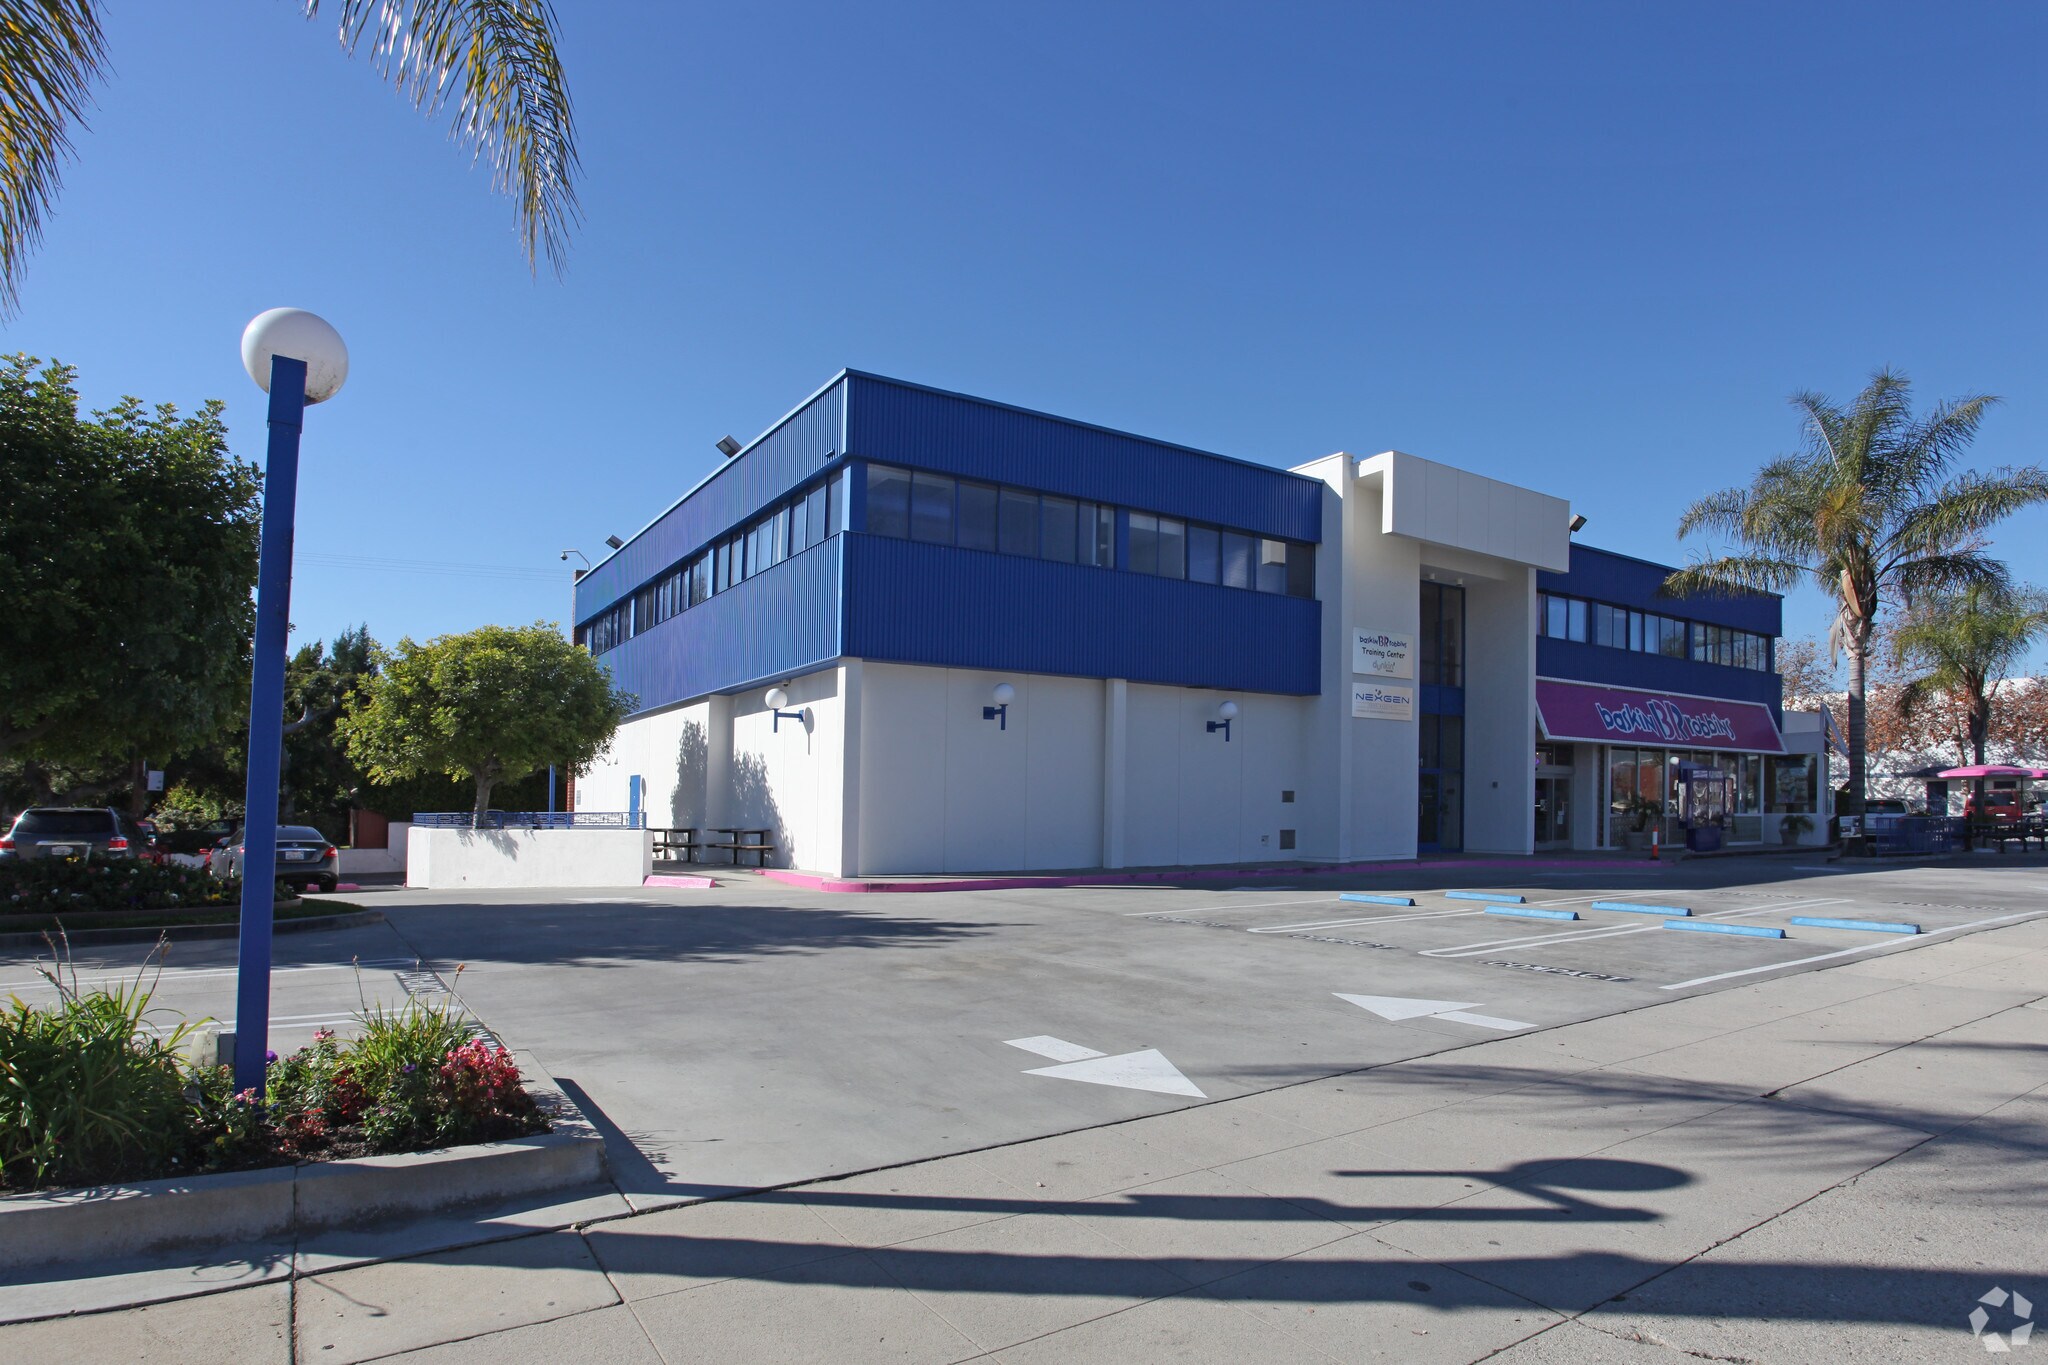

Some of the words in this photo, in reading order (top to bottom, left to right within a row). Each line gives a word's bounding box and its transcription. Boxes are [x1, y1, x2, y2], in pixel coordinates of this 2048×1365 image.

[1378, 635, 1389, 647] BR
[1362, 647, 1385, 659] Training
[1386, 650, 1405, 659] Center
[1355, 693, 1410, 704] NEXGEN
[1595, 702, 1658, 734] baskin
[1647, 699, 1690, 741] BR
[1684, 713, 1736, 741] robbins
